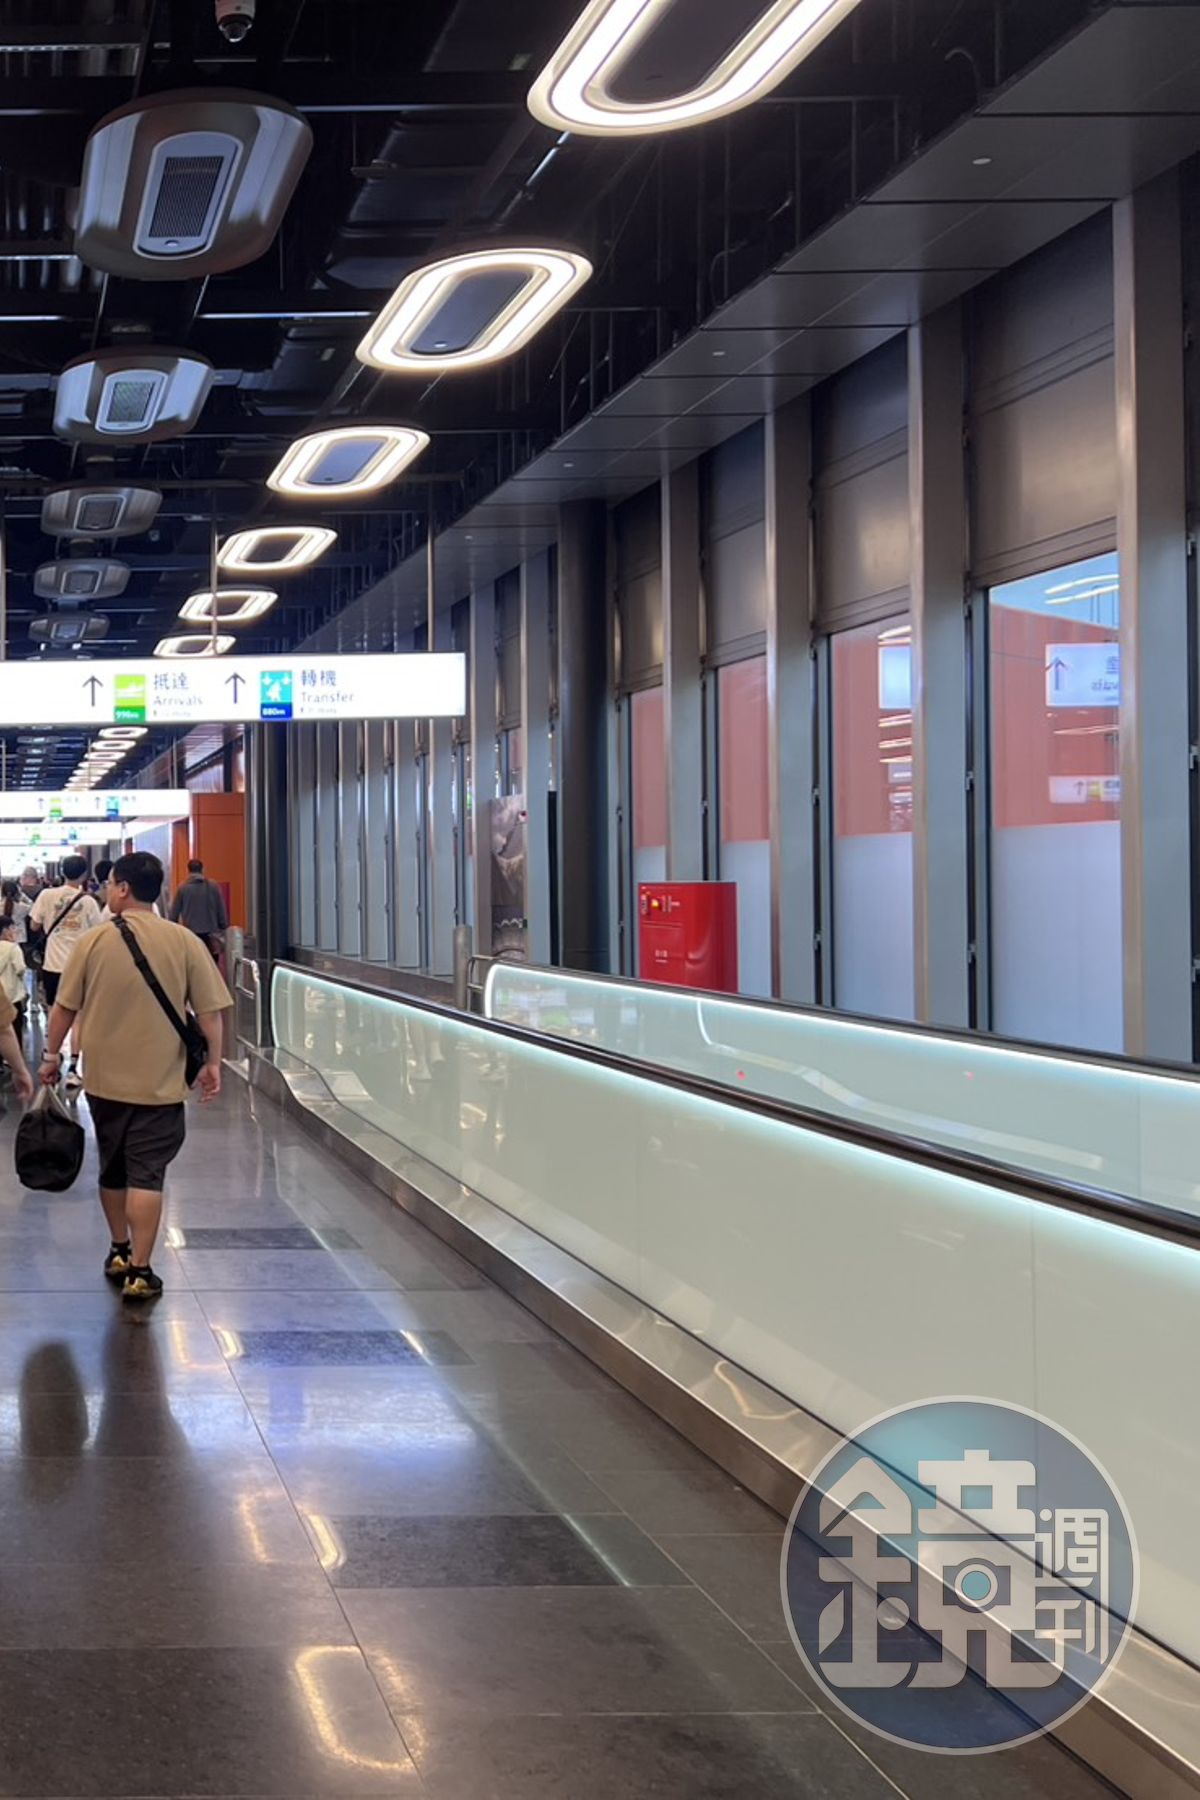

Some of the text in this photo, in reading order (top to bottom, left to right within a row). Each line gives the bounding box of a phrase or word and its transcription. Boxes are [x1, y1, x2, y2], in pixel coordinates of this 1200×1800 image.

[153, 672, 189, 690] 抵達
[301, 669, 337, 687] 轉機
[153, 694, 203, 706] Arrivals
[301, 690, 355, 703] Transfer
